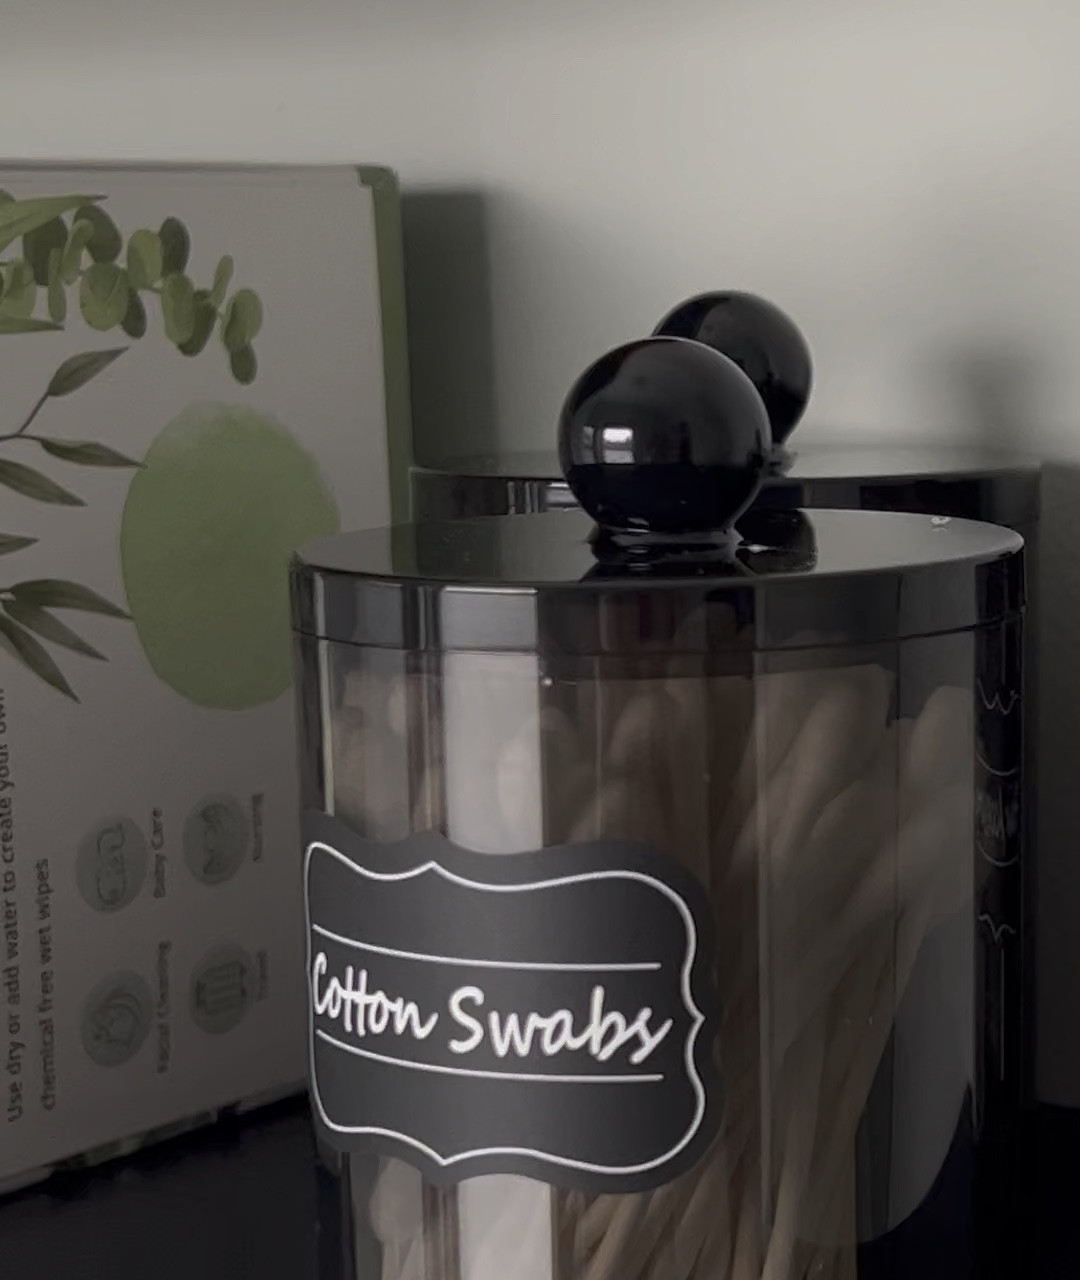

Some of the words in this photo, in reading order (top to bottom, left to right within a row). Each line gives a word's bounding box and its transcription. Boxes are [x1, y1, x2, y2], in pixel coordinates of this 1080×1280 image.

[0, 797, 14, 864] create
[151, 806, 163, 850] Care
[2, 869, 16, 892] to
[36, 858, 54, 920] wipes
[4, 898, 19, 960] water
[38, 925, 52, 964] wet
[3, 966, 20, 1005] add
[38, 971, 53, 1013] free
[9, 1013, 20, 1035] or
[312, 951, 439, 1040] Cotton
[448, 986, 674, 1064] Swabs
[7, 1041, 26, 1075] dry
[39, 1019, 55, 1111] chemical
[7, 1081, 23, 1122] Use
